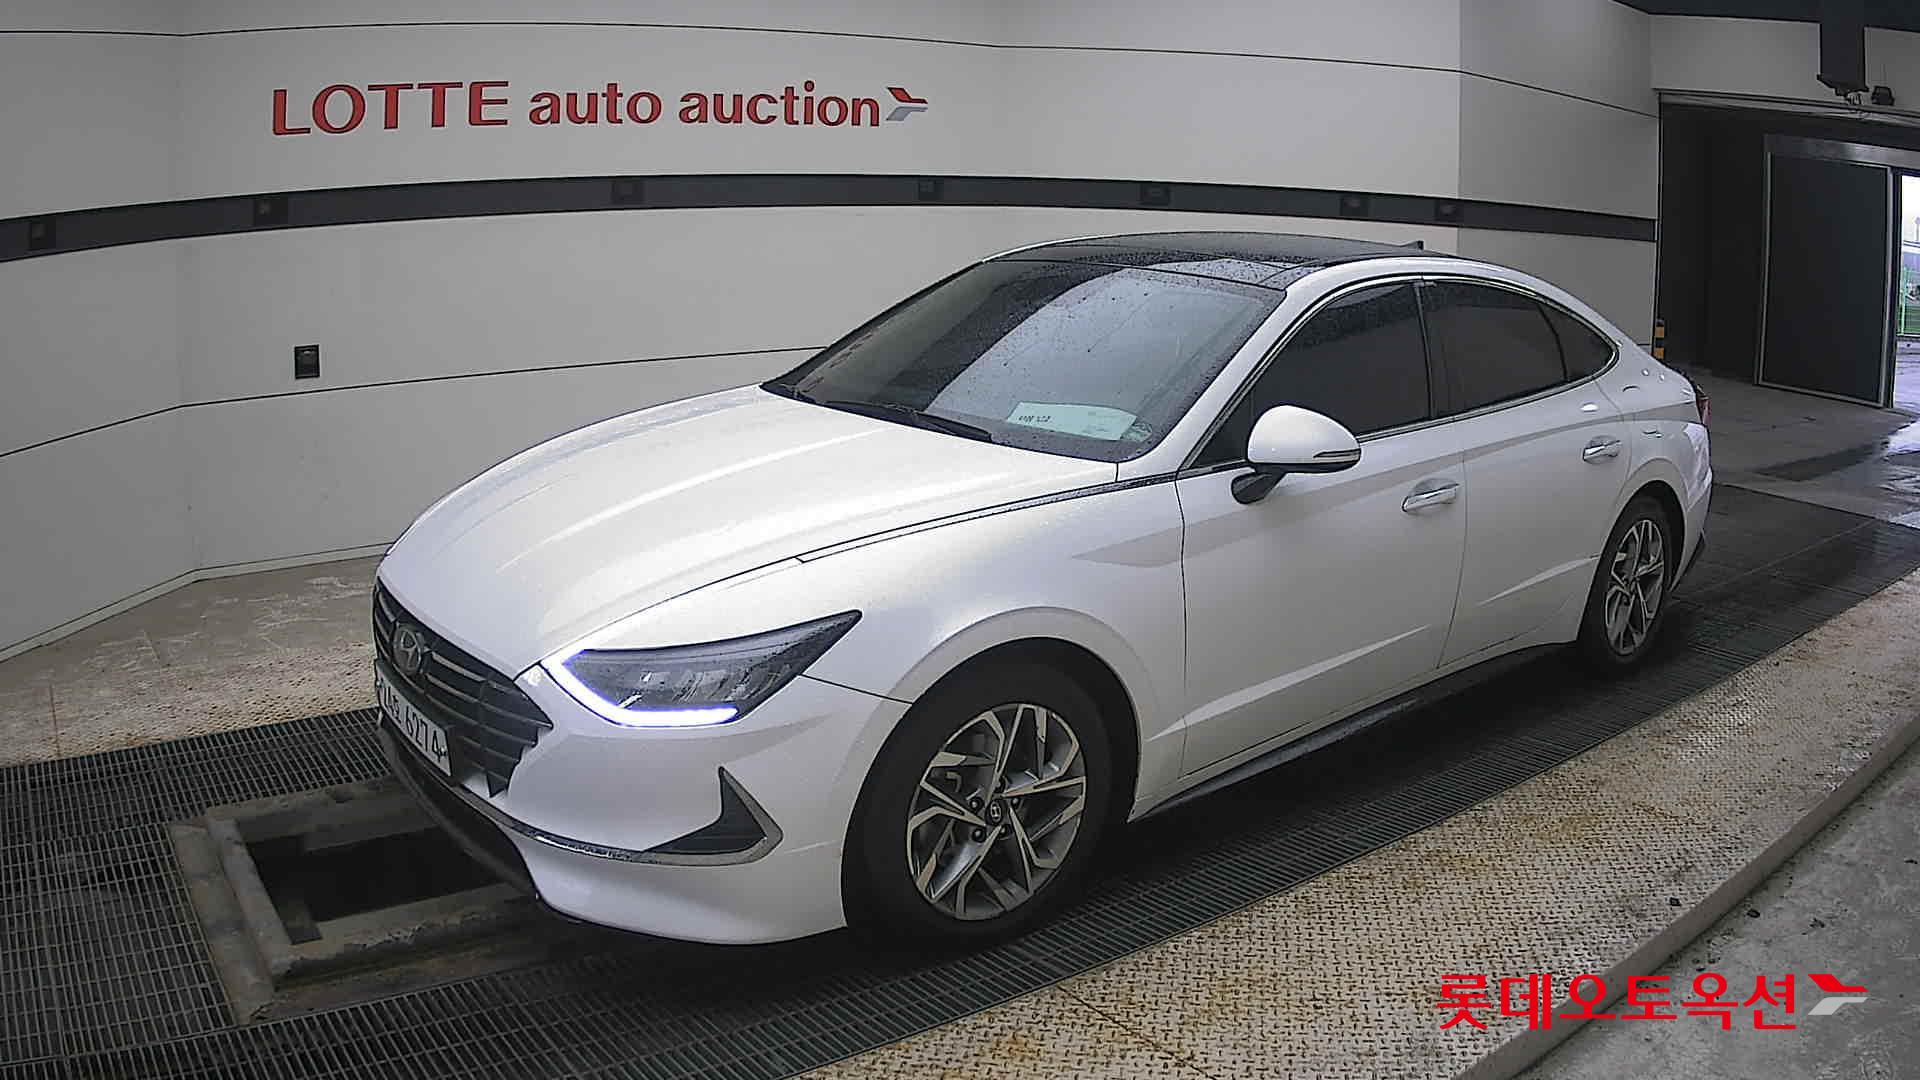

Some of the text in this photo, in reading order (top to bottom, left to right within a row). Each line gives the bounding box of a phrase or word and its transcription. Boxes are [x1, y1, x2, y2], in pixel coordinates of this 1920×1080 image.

[272, 81, 880, 136] LOTTE auto auction
